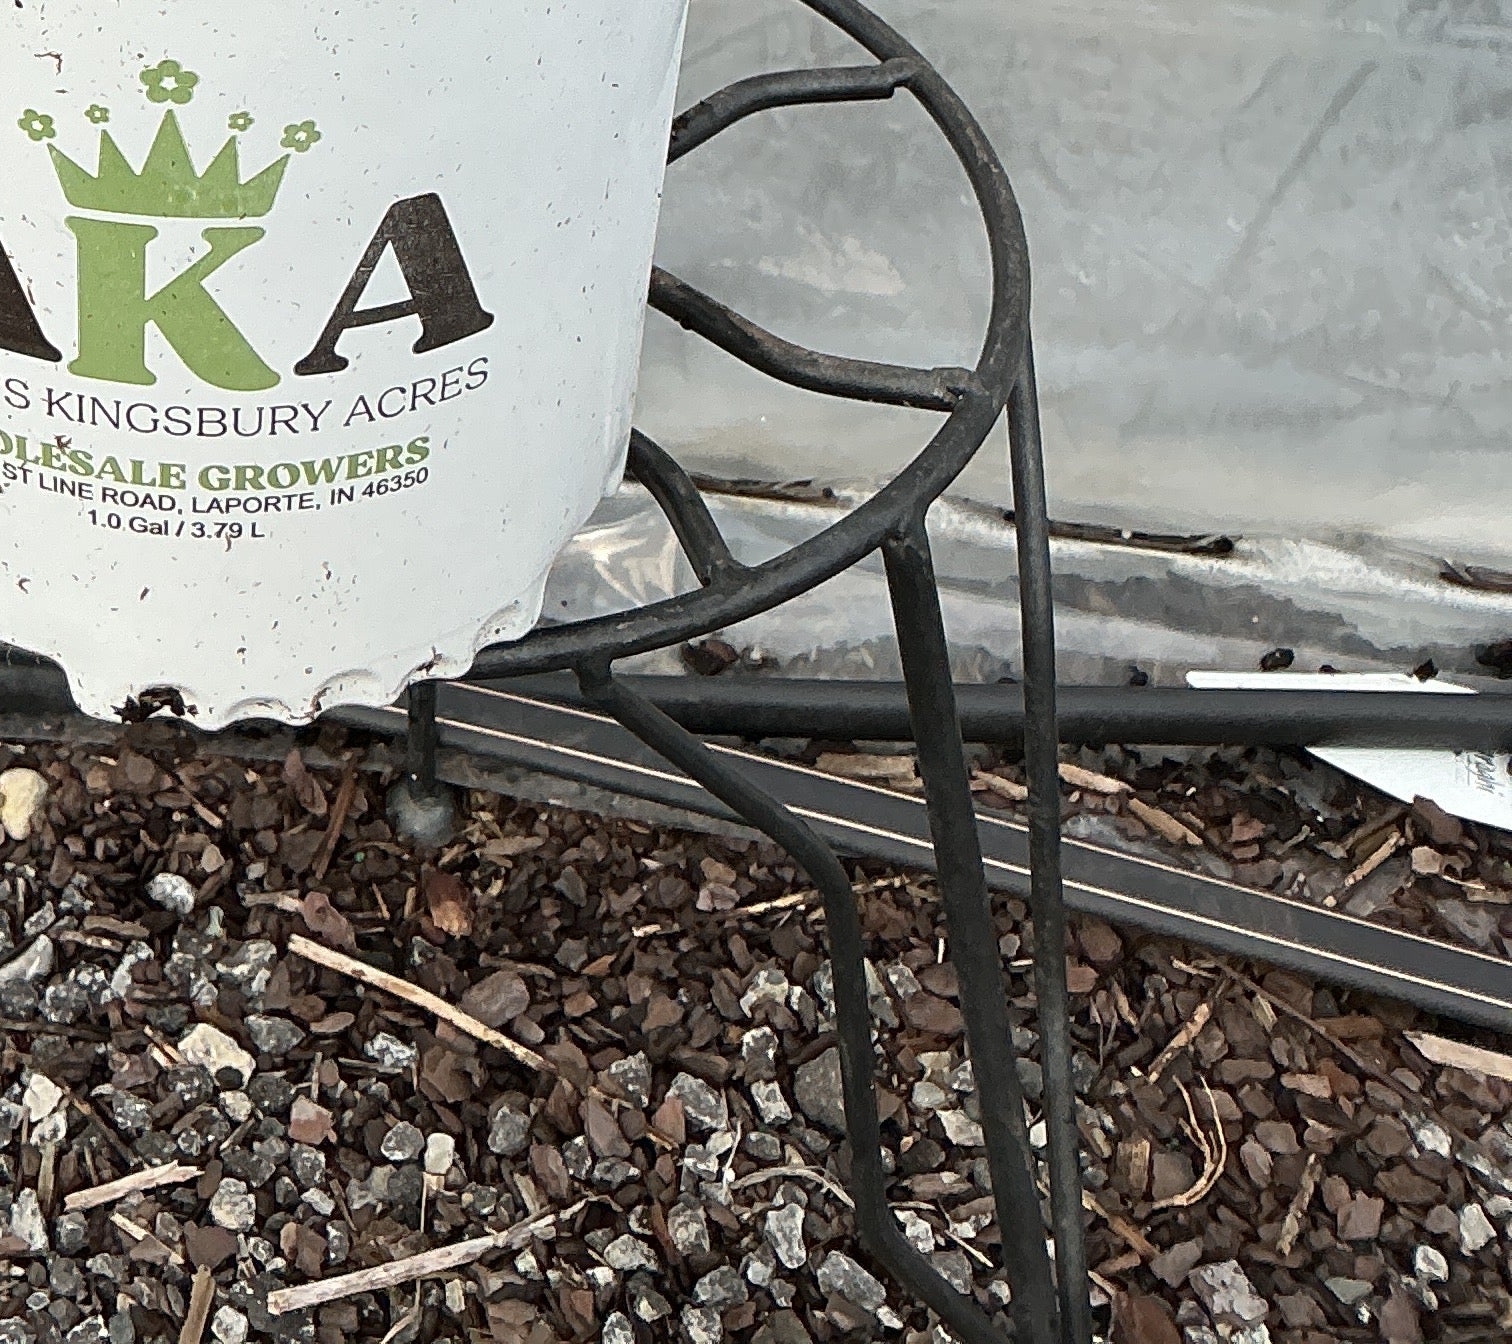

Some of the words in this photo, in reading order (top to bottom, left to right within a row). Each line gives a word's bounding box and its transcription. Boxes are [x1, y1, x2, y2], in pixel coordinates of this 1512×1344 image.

[45, 387, 332, 437] KINGSBURY
[343, 356, 489, 427] ACRES
[197, 435, 431, 491] GROWERS
[39, 472, 93, 500] LINE
[101, 486, 183, 514] ROAD,
[191, 492, 321, 515] LAPORTE,
[330, 485, 354, 506] IN
[361, 466, 429, 498] 46350
[87, 509, 122, 530] 1.0
[128, 515, 169, 536] Gal
[174, 520, 185, 537] /
[190, 521, 243, 539] 3.79
[250, 521, 265, 538] L
